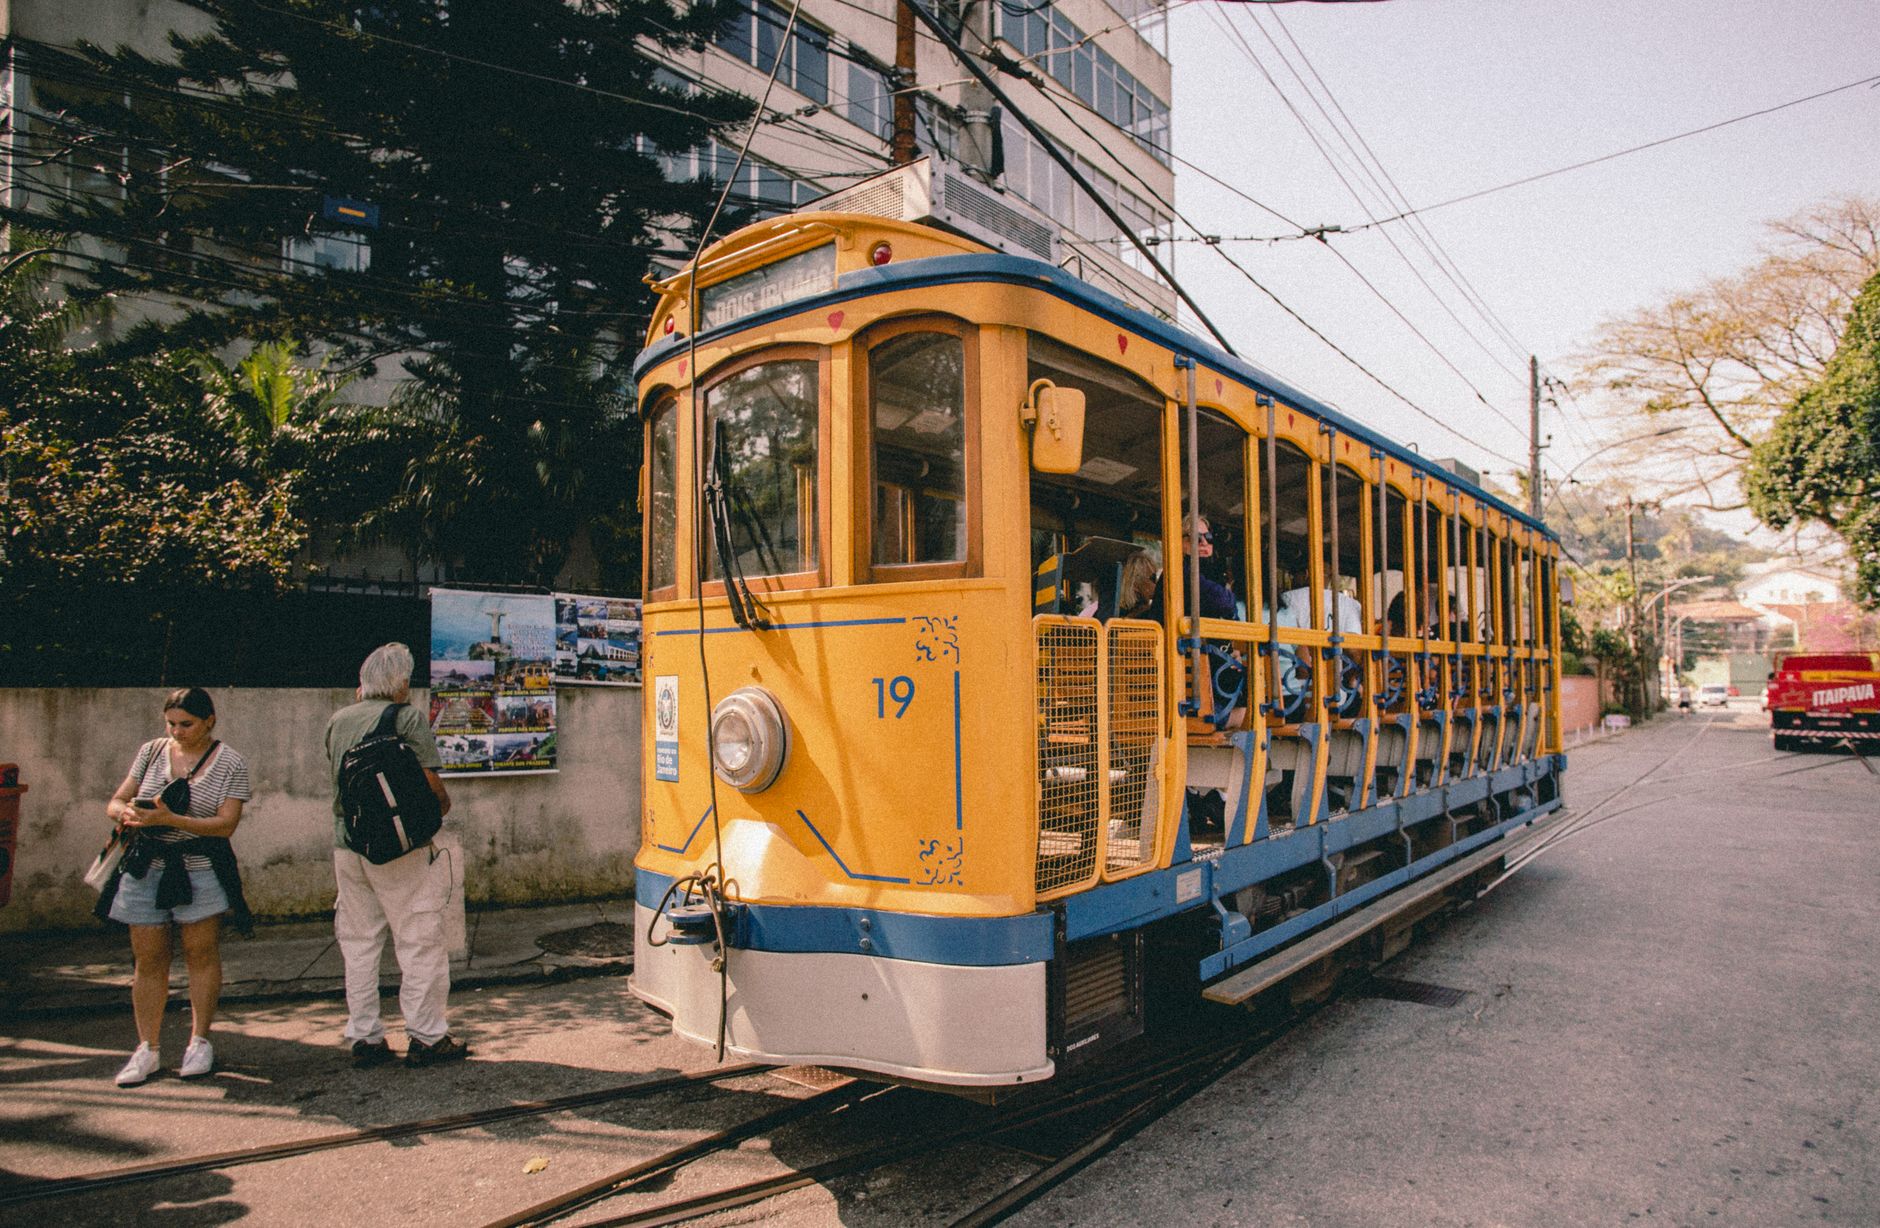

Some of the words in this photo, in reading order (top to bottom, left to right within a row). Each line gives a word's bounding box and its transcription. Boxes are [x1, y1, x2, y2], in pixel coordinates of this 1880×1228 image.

[715, 291, 754, 322] DOIS
[872, 676, 915, 719] 19
[1812, 683, 1875, 707] ITAIPAVA
[665, 756, 673, 765] de
